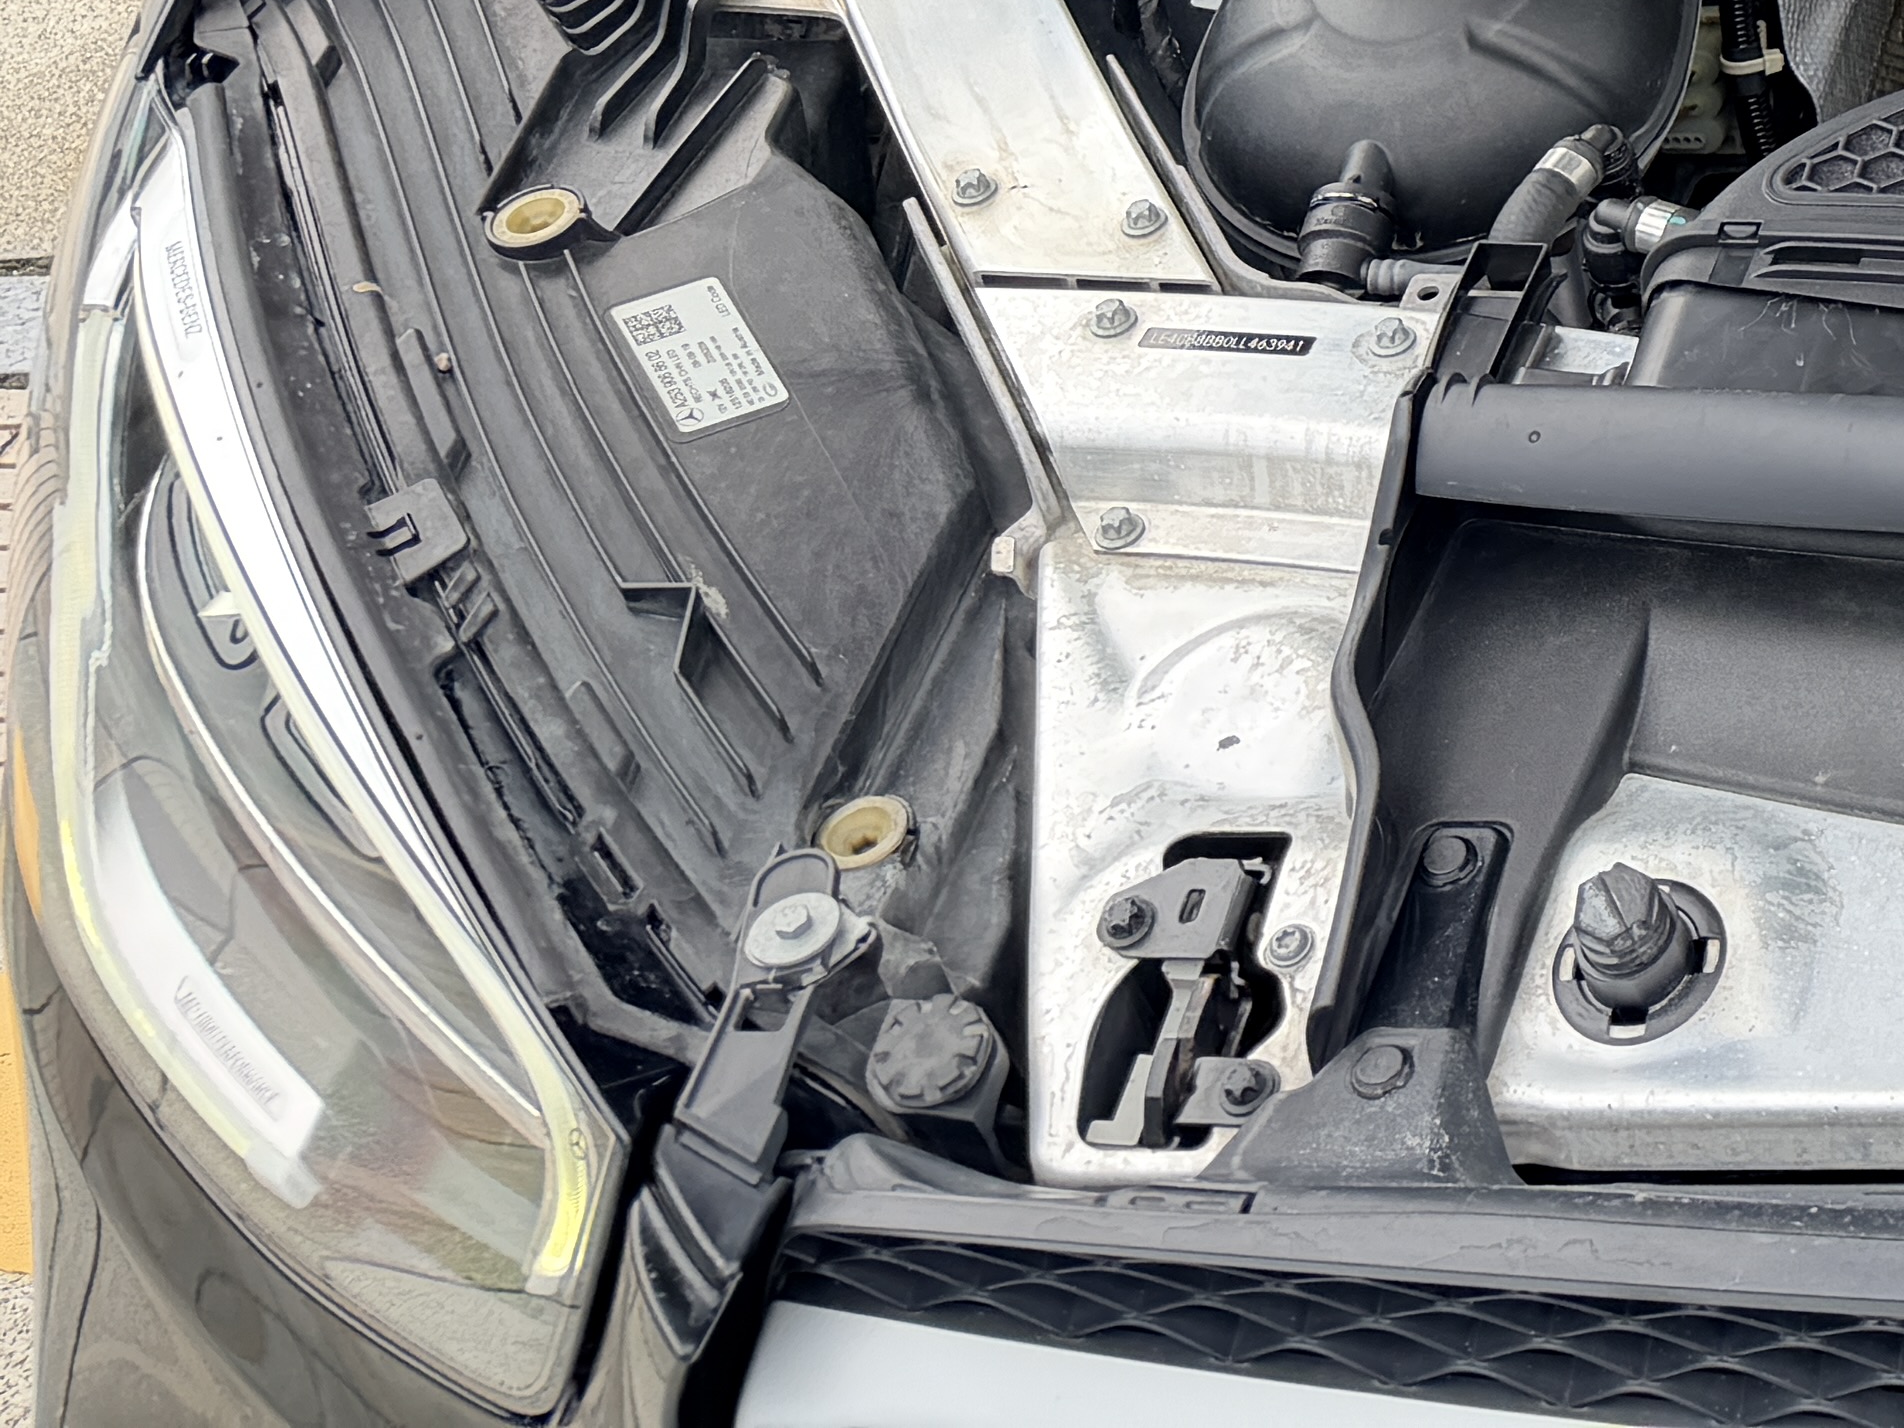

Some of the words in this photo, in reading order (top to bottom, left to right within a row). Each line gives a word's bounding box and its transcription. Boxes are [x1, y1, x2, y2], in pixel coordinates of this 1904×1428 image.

[715, 303, 730, 317] LED
[750, 358, 764, 376] Made
[667, 387, 689, 408] A253
